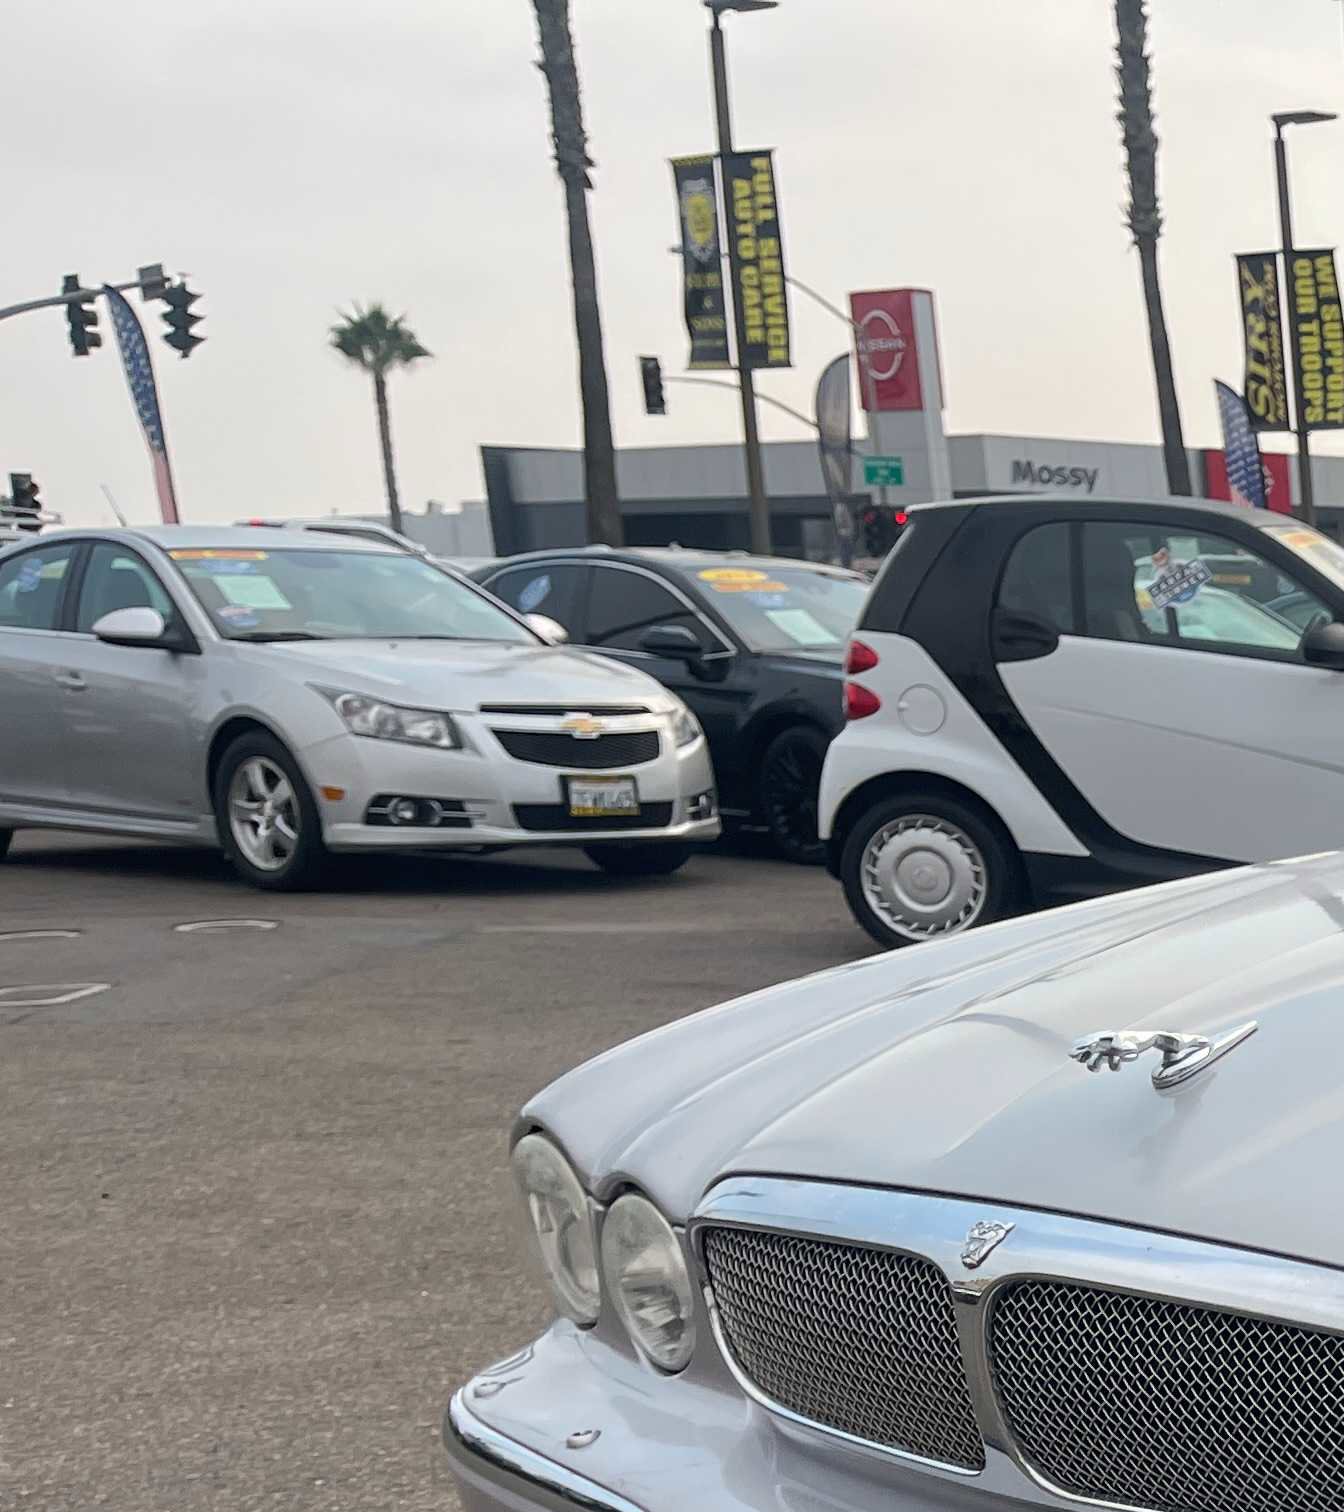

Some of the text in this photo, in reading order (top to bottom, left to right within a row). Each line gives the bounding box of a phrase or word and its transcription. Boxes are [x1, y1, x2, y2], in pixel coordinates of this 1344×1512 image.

[733, 178, 766, 343] AUTO CARE
[751, 157, 787, 361] FULL SERVICE
[1293, 258, 1325, 423] OUR TROOPS
[1315, 256, 1337, 298] WE
[1011, 460, 1098, 493] Mossy
